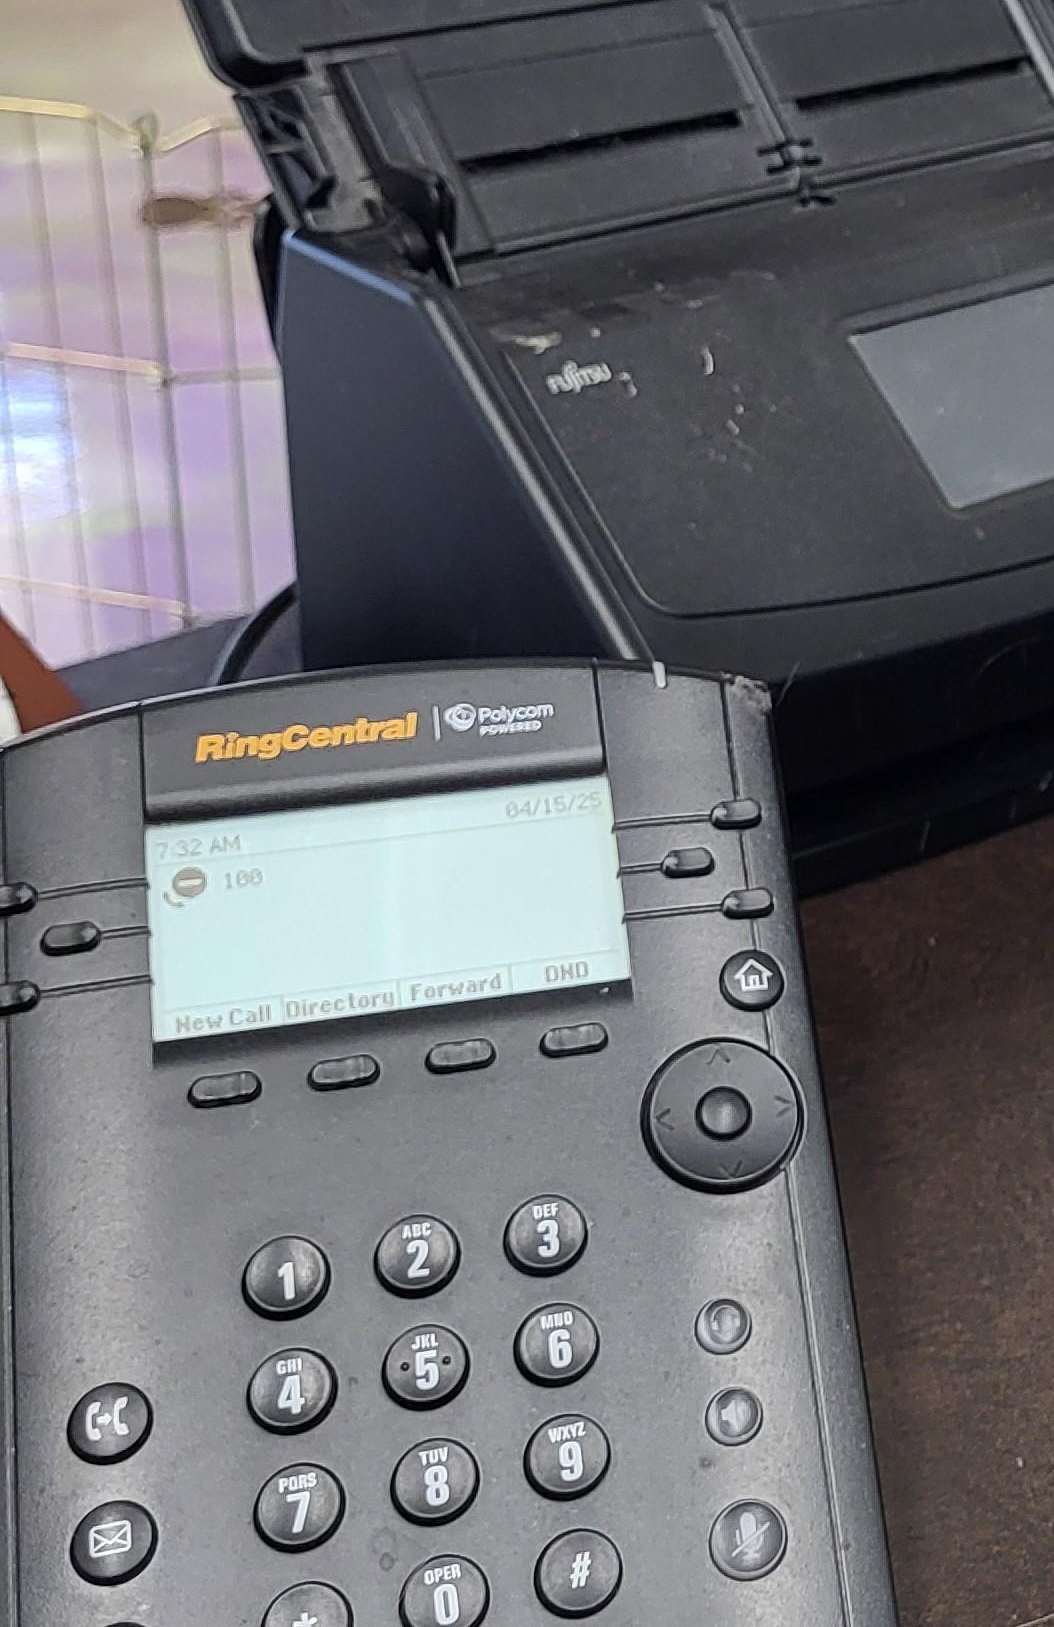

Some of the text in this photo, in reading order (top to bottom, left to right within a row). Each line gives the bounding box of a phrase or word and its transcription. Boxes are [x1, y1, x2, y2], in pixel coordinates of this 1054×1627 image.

[477, 703, 555, 724] Polycom
[195, 711, 418, 764] RingCentral
[478, 719, 543, 737] POWERED
[505, 791, 603, 819] 04/15/25
[209, 834, 242, 854] AM
[224, 868, 264, 891] 100
[175, 1014, 224, 1035] New
[228, 1004, 273, 1028] Call
[285, 988, 396, 1020] Directory
[408, 972, 503, 1005] Forward
[531, 1203, 560, 1221] DEF
[401, 1222, 432, 1240] ABC
[535, 1218, 561, 1258] 3
[406, 1239, 431, 1279] 2
[277, 1261, 296, 1301] 1
[411, 1333, 440, 1351] JKL
[547, 1328, 573, 1369] 6
[276, 1357, 303, 1376] GHI
[414, 1349, 440, 1391] 5
[277, 1374, 306, 1415] 4
[547, 1421, 587, 1444] WXYZ
[418, 1446, 450, 1466] TUV
[558, 1440, 584, 1482] 9
[277, 1472, 318, 1494] PQRS
[423, 1464, 451, 1507] 8
[285, 1490, 312, 1534] 7
[423, 1562, 462, 1585] OPER
[432, 1583, 461, 1626] 0
